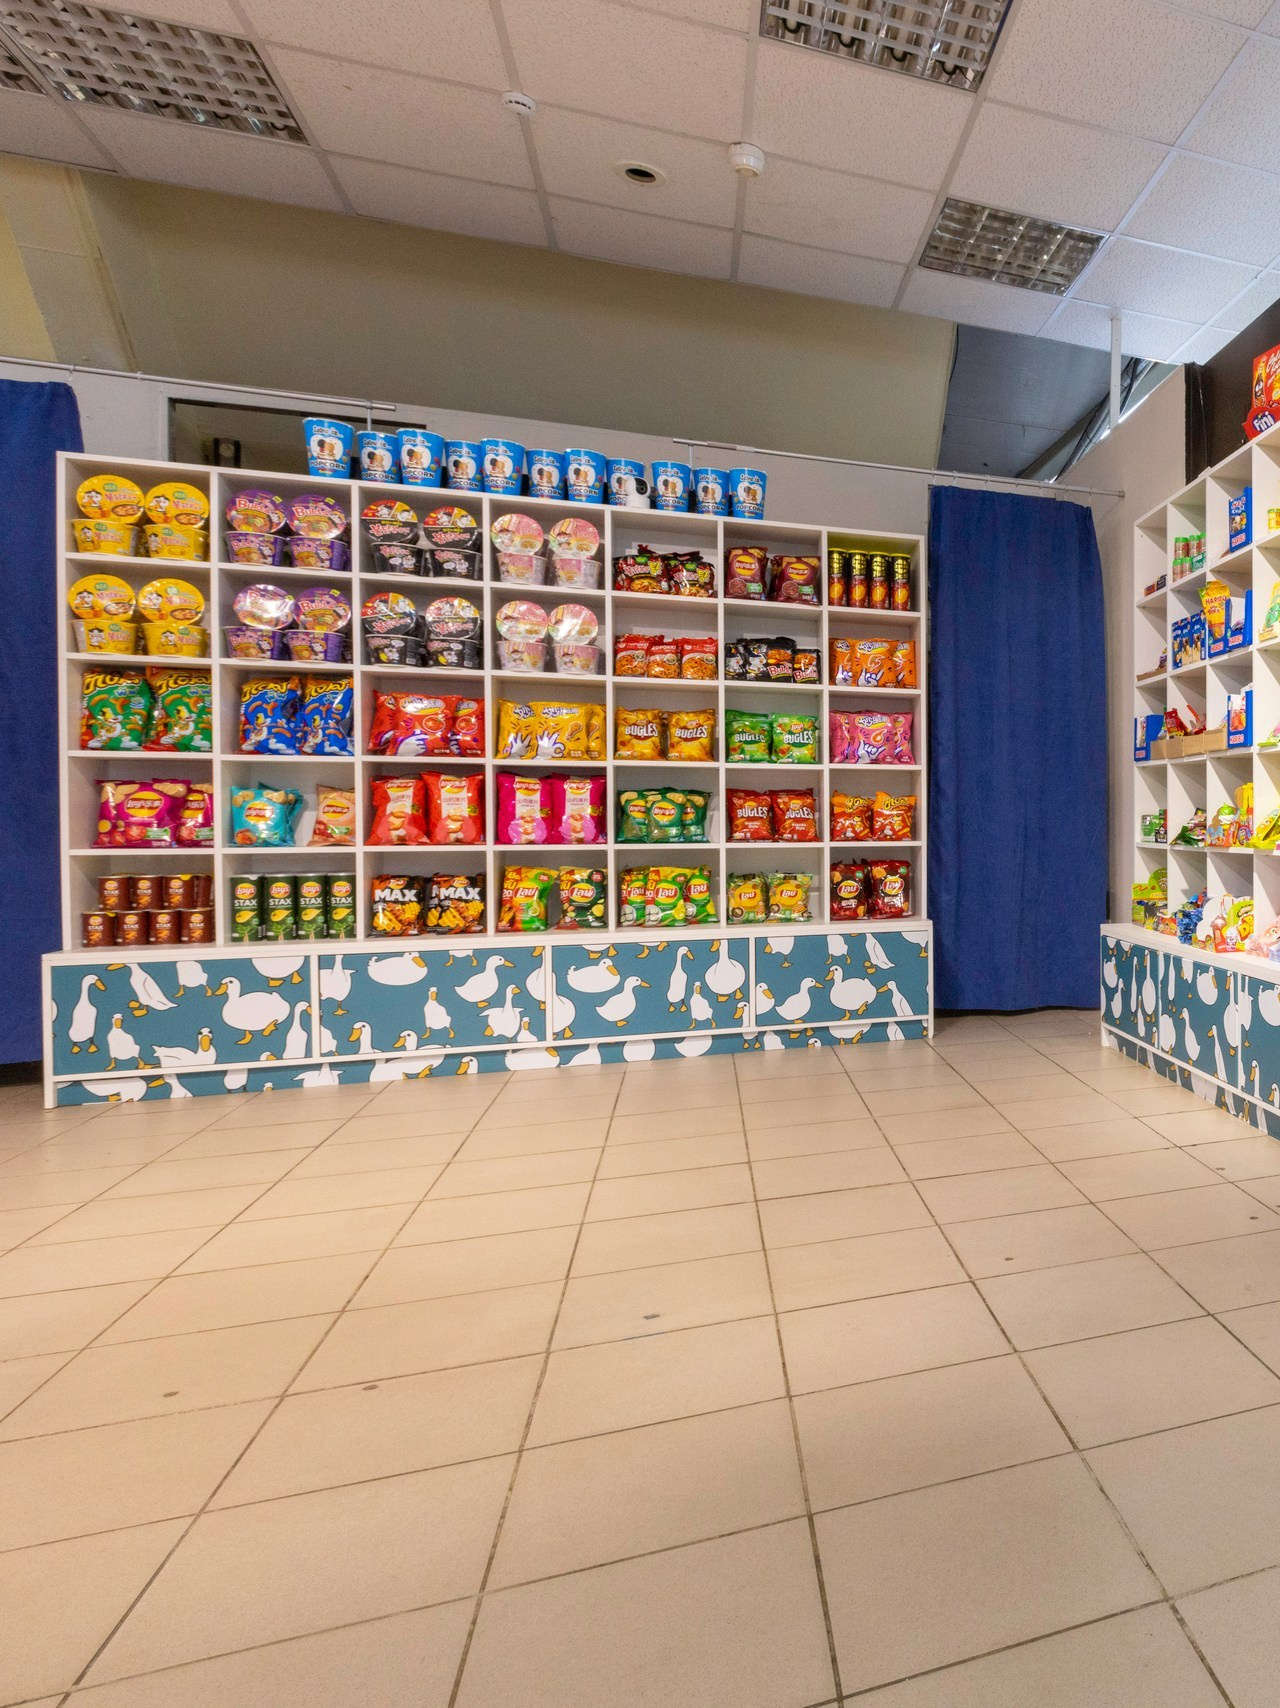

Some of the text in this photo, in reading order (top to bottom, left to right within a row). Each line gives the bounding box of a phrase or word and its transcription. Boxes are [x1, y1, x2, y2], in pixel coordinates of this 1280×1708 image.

[1253, 411, 1275, 432] Fini
[625, 724, 658, 737] BUGLES
[675, 726, 708, 738] BUGLES
[784, 730, 813, 743] BUGLES
[735, 733, 765, 742] BUGLES
[737, 807, 768, 818] BUGLES
[374, 889, 418, 901] MAX
[440, 887, 480, 900] MAX
[300, 897, 322, 905] STAX
